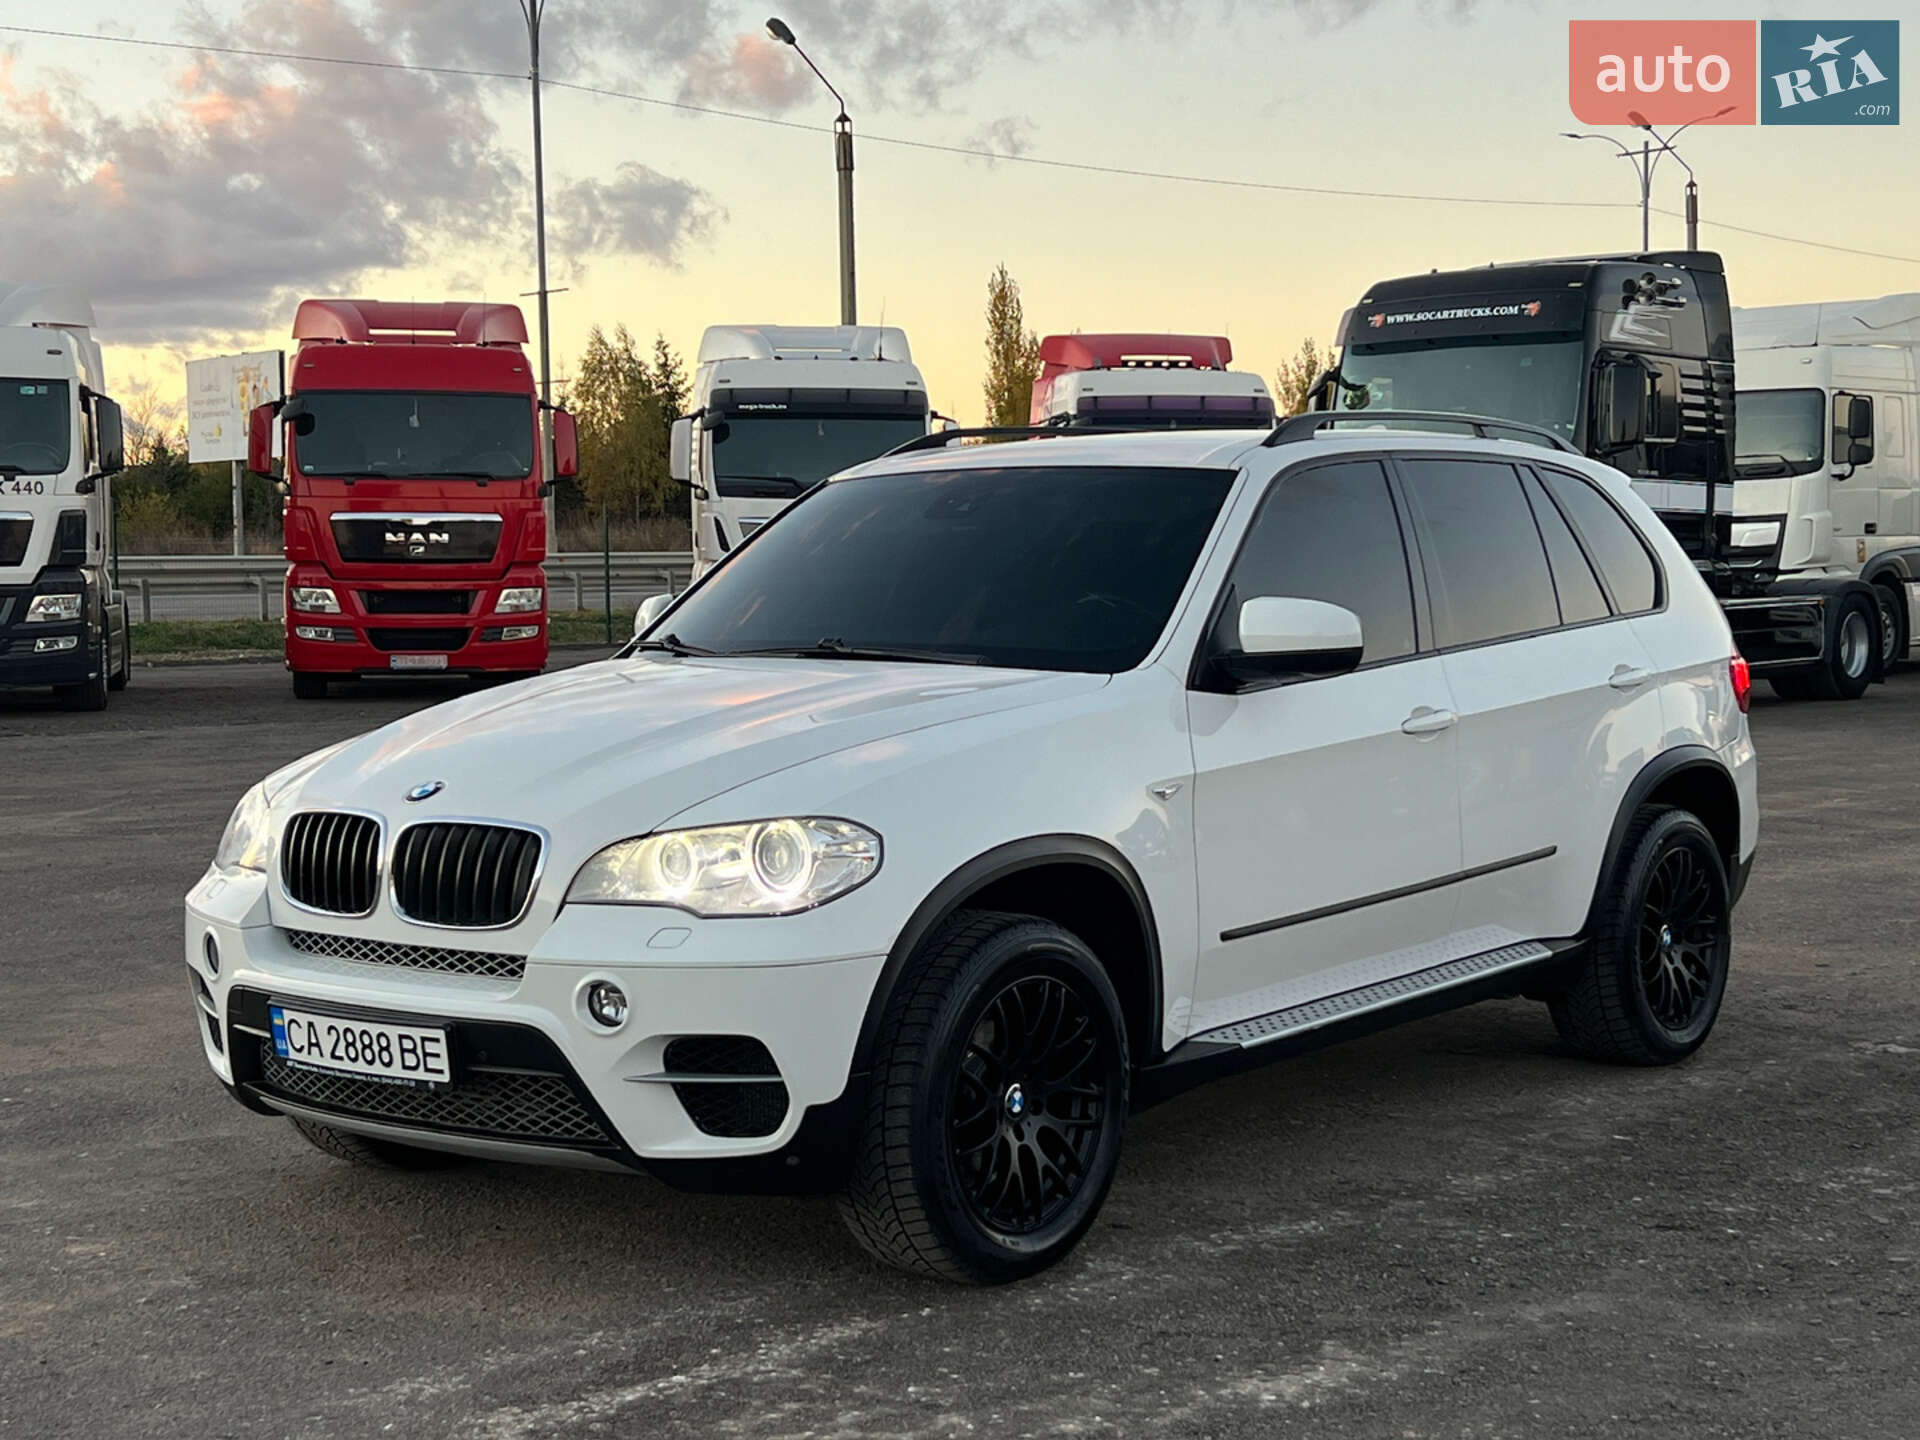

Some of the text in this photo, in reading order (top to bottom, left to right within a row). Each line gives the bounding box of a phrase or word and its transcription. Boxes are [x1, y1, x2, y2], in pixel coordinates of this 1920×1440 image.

[1386, 305, 1519, 325] WWW.SOCARTRUCKS.COM
[11, 480, 44, 496] 440
[384, 531, 450, 545] MAN
[276, 1039, 288, 1050] UA
[287, 1018, 324, 1059] CA
[327, 1025, 394, 1068] 2888
[398, 1033, 445, 1075] BE
